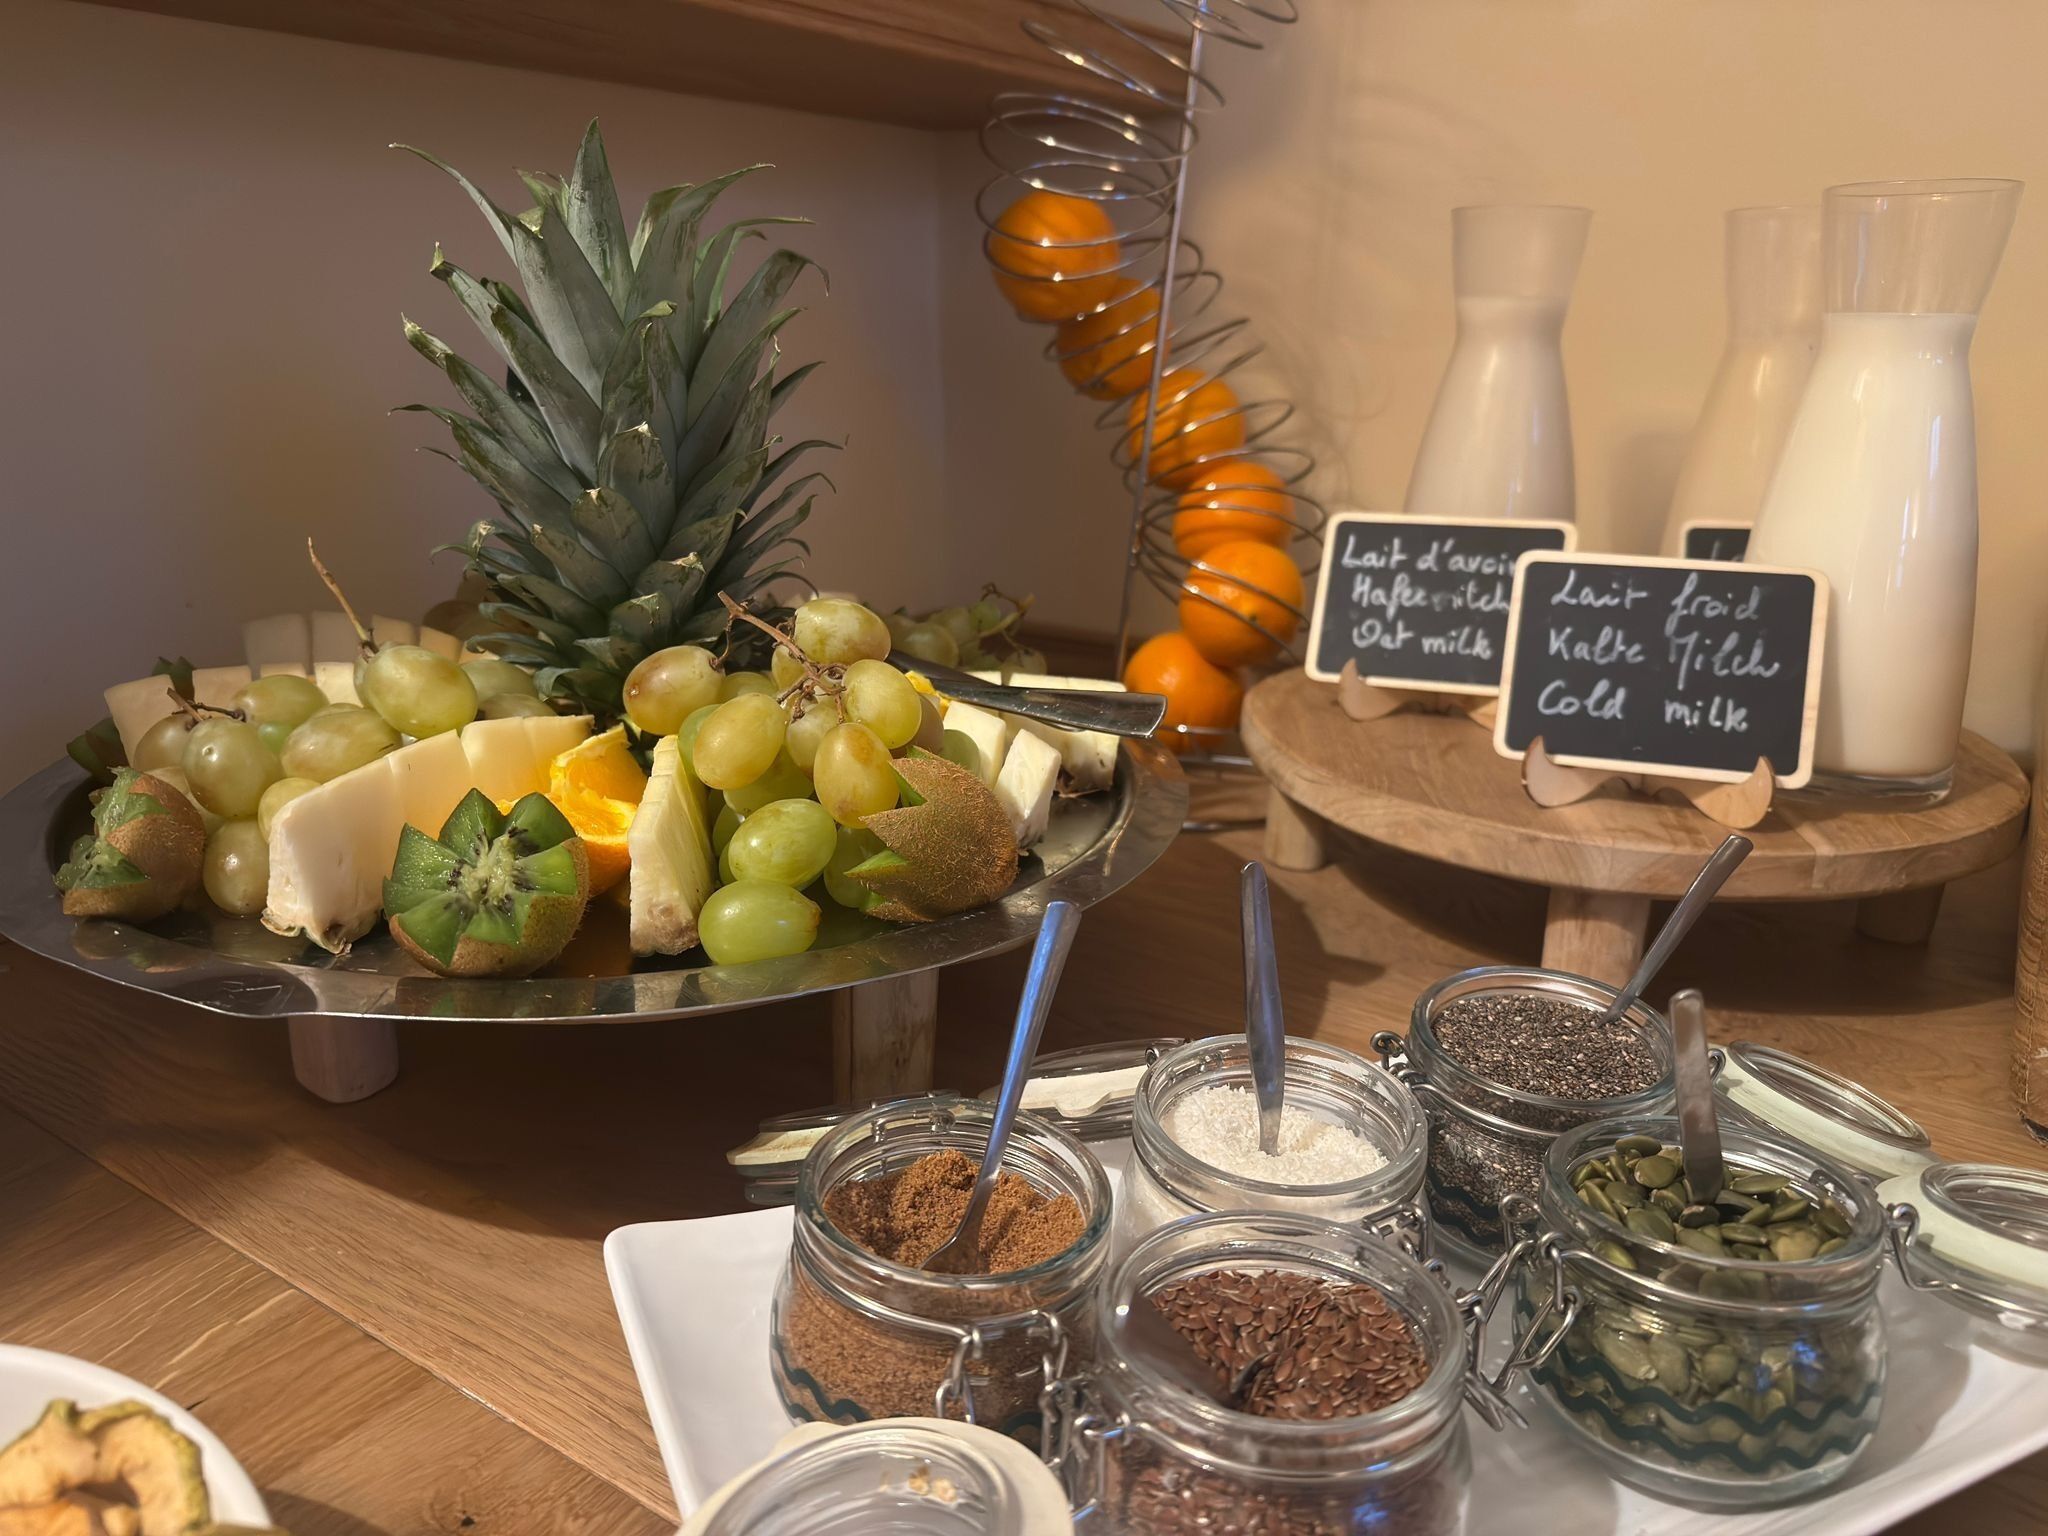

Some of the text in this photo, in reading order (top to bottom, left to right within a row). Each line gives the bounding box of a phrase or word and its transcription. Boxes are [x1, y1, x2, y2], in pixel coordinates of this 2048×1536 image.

[1341, 533, 1409, 569] Lait
[1550, 568, 1761, 637] Lait froid
[1352, 618, 1493, 660] Oat milk
[1548, 625, 1781, 691] Kalte Milch
[1537, 678, 1749, 733] Cold milk
